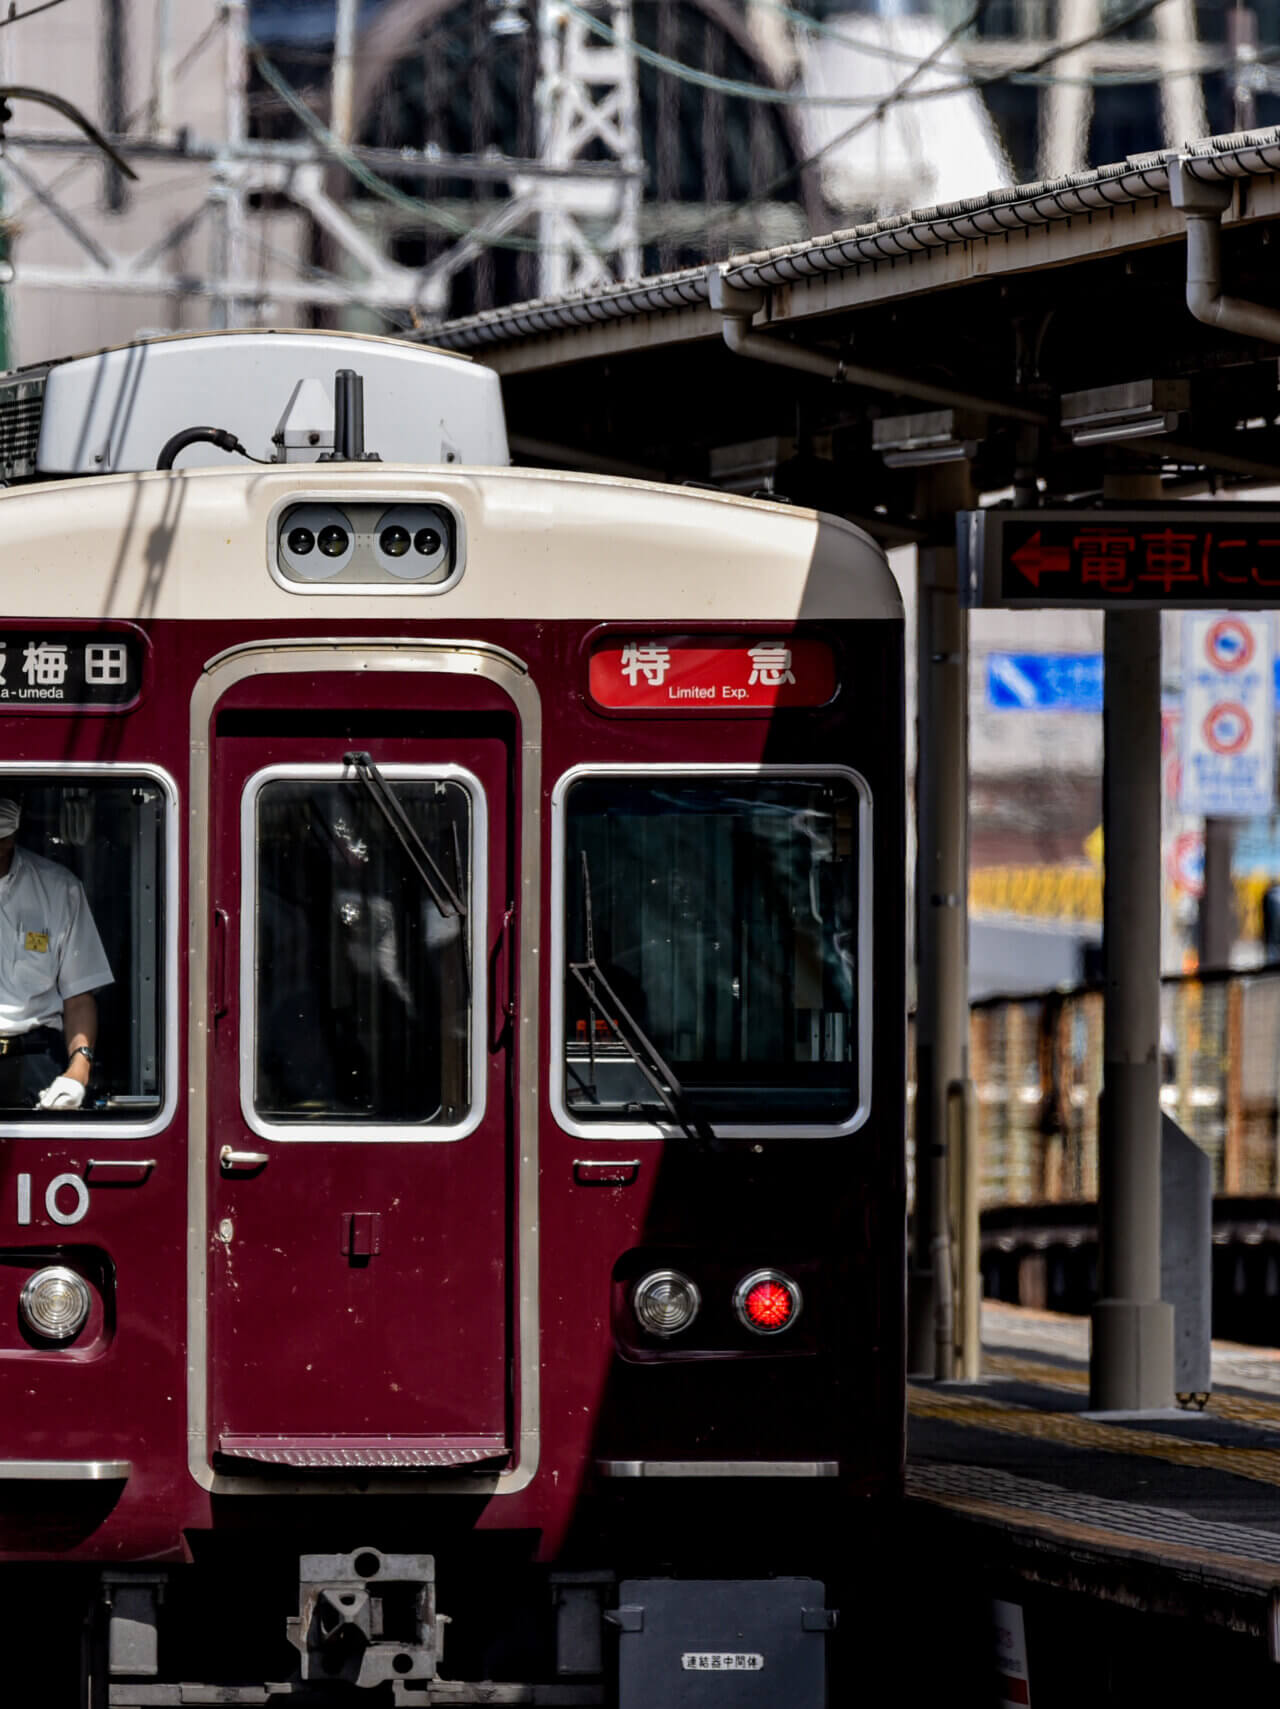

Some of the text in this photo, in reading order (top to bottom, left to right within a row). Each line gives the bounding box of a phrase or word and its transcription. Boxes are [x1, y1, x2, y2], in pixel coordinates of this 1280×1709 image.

[620, 641, 797, 687] 特急
[669, 686, 750, 700] Limited Exp.
